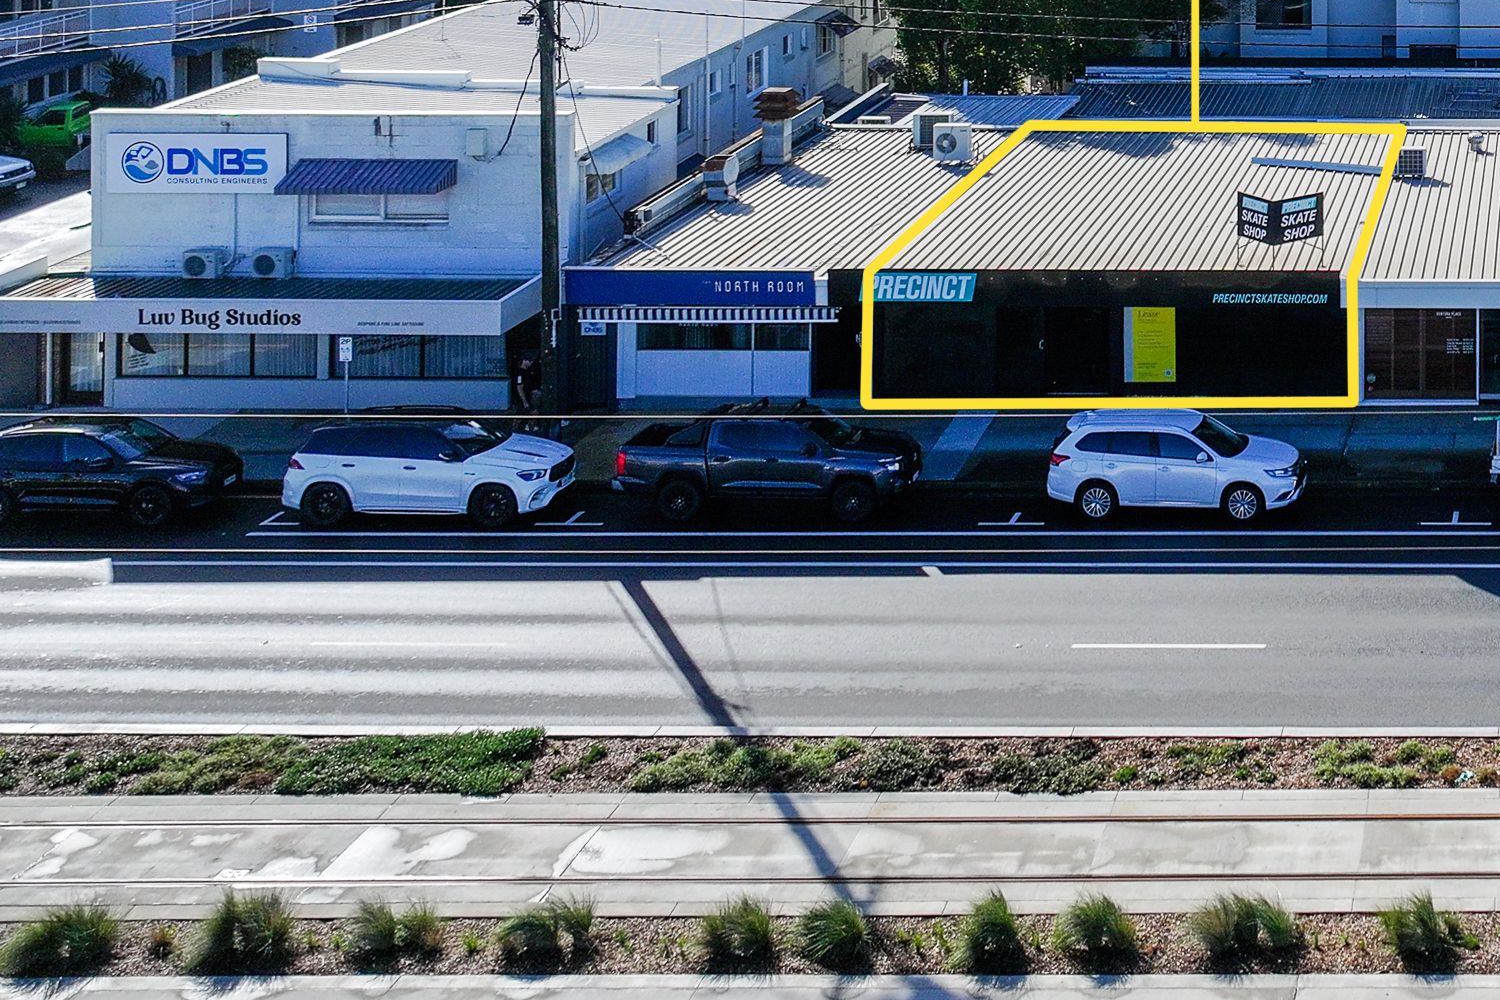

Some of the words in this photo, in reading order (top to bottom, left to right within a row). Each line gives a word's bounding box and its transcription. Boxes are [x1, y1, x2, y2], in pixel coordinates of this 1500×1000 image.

[166, 148, 269, 176] DNBS
[1241, 209, 1269, 227] SKATE
[1280, 209, 1318, 227] SKATE
[1243, 224, 1267, 240] SHOP
[1283, 224, 1316, 241] SHOP
[714, 280, 760, 292] NORTH
[767, 280, 805, 292] ROOM
[1212, 293, 1328, 304] PRECINCTSKATESHOP.COM
[138, 308, 175, 326] Luv
[180, 308, 221, 330] Bug
[225, 308, 302, 326] Studios
